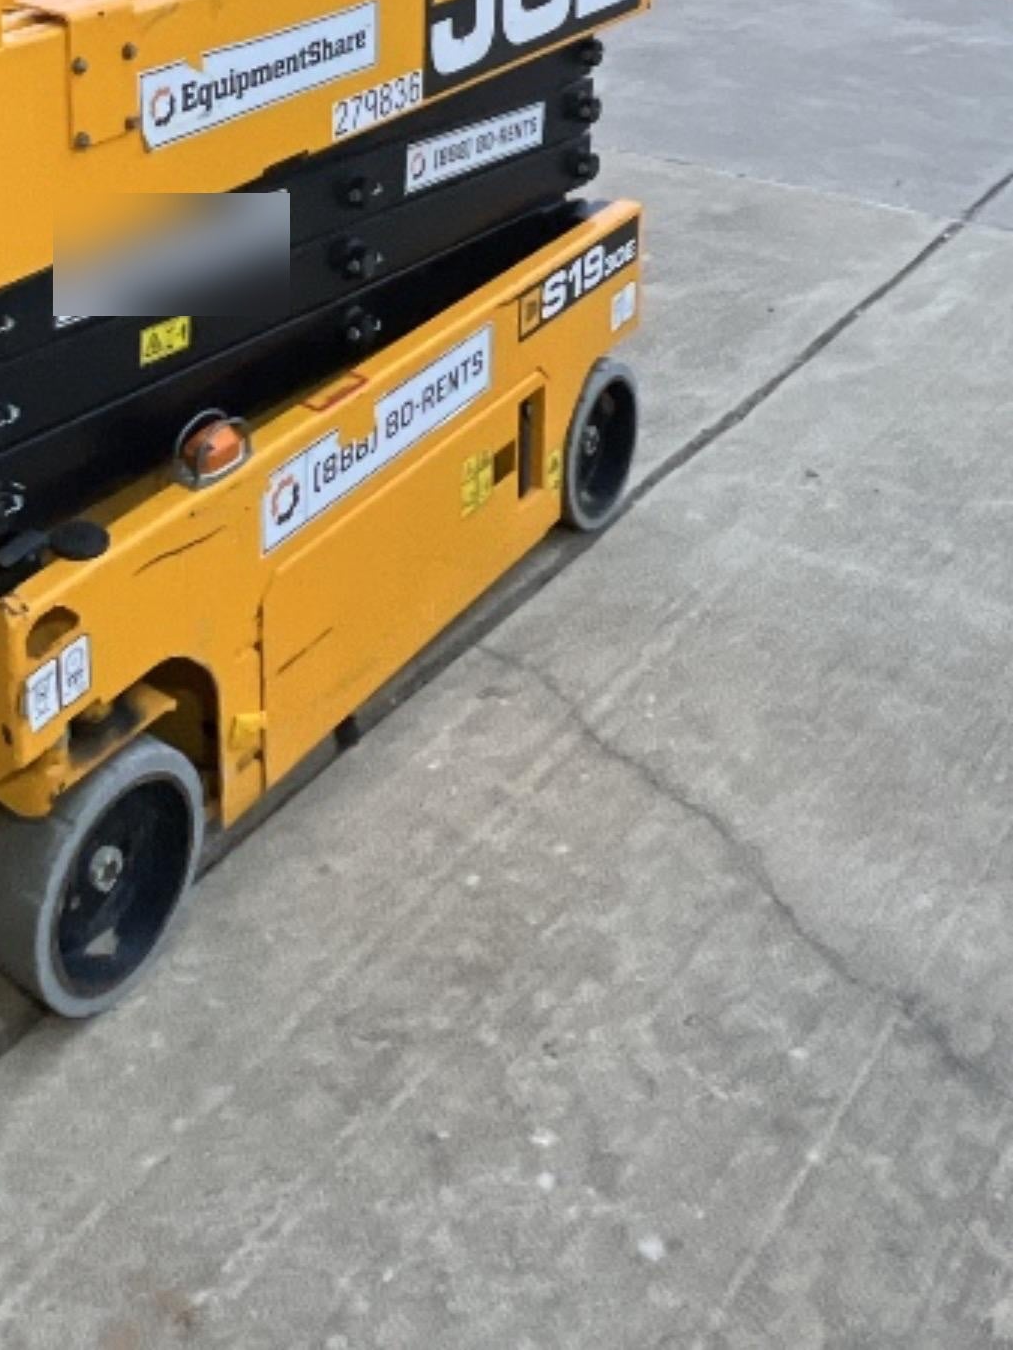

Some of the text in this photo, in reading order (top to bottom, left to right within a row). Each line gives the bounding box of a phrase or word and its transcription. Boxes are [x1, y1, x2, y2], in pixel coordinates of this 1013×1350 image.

[181, 29, 366, 113] EquipmentShare
[334, 73, 420, 136] 279836
[385, 350, 484, 439] 80-RENTS
